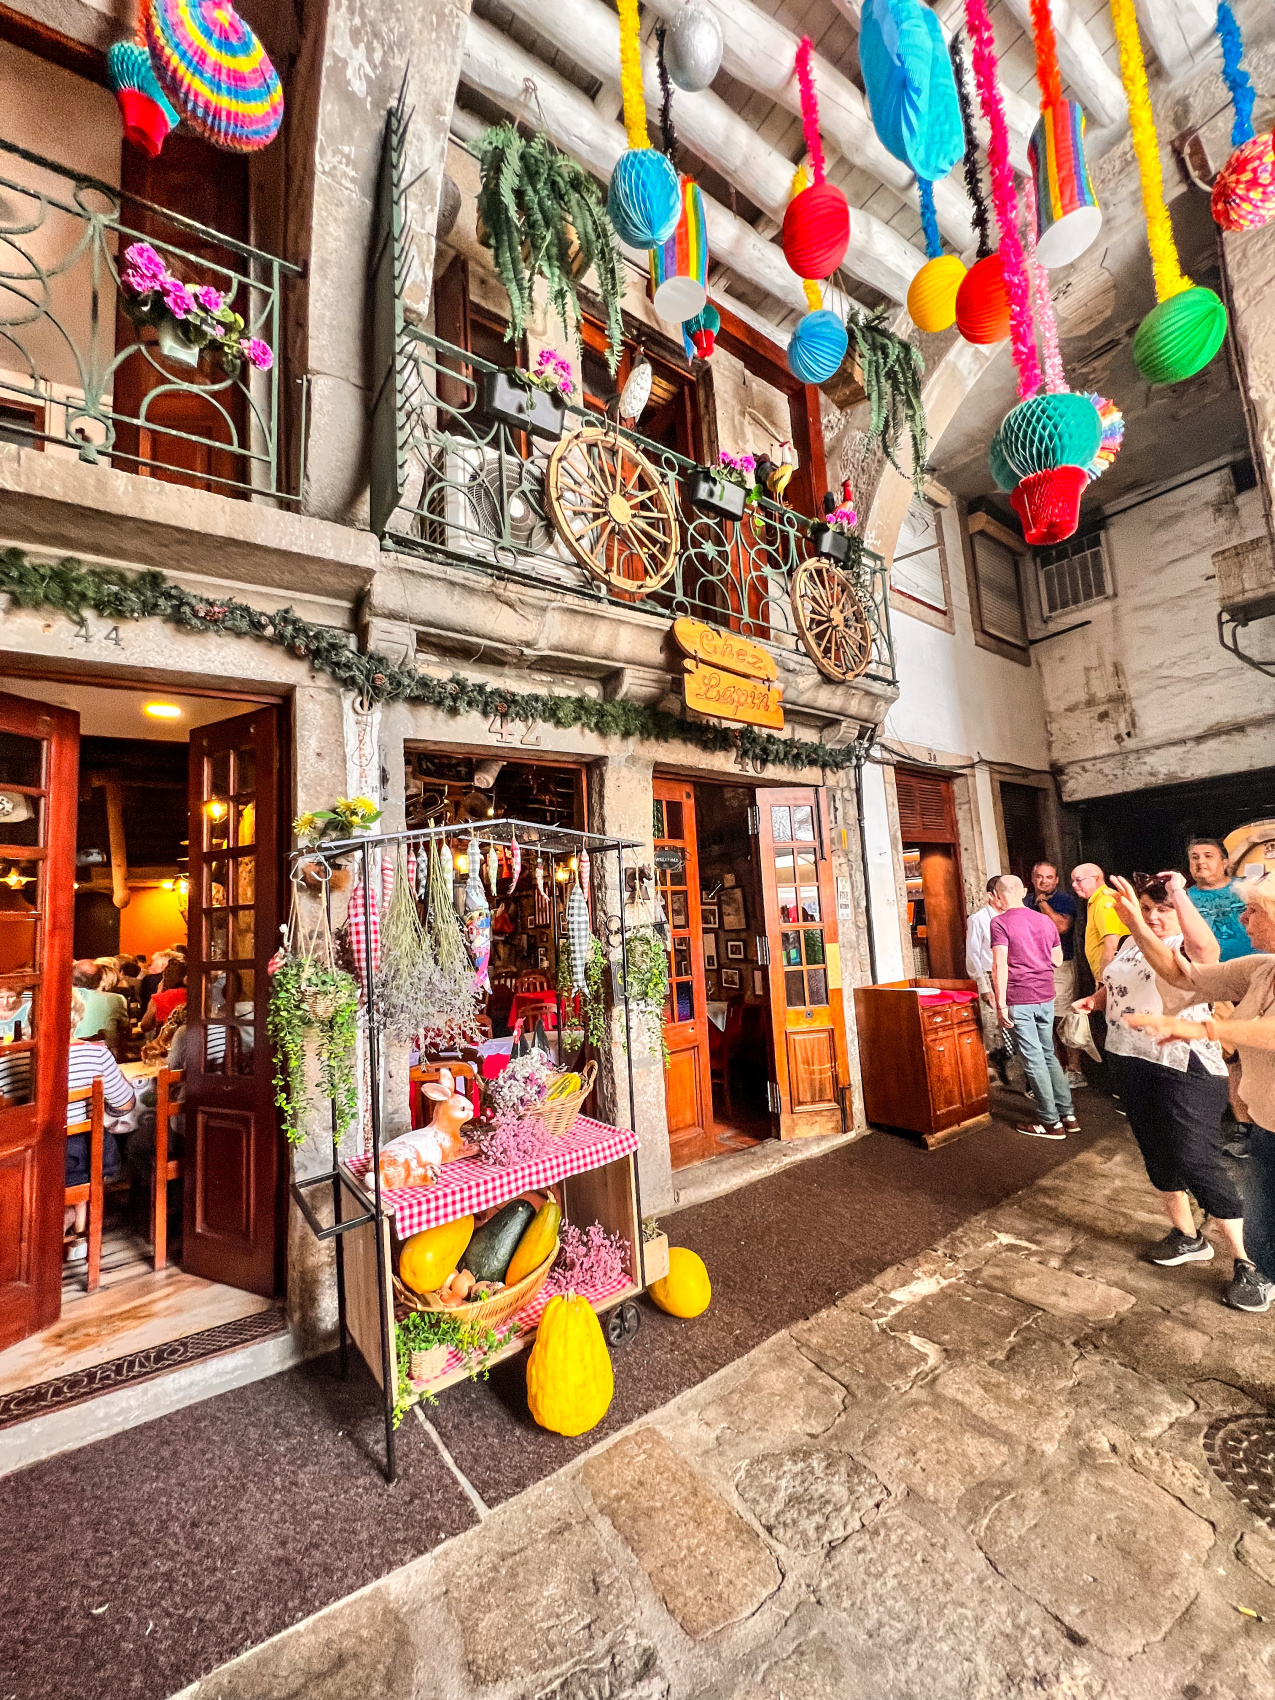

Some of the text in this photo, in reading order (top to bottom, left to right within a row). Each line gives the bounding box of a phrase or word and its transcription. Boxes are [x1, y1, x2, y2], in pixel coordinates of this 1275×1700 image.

[74, 620, 123, 646] 44
[700, 630, 763, 671] Chez
[696, 673, 769, 715] Lapin
[488, 713, 541, 746] 42
[734, 747, 766, 774] 40
